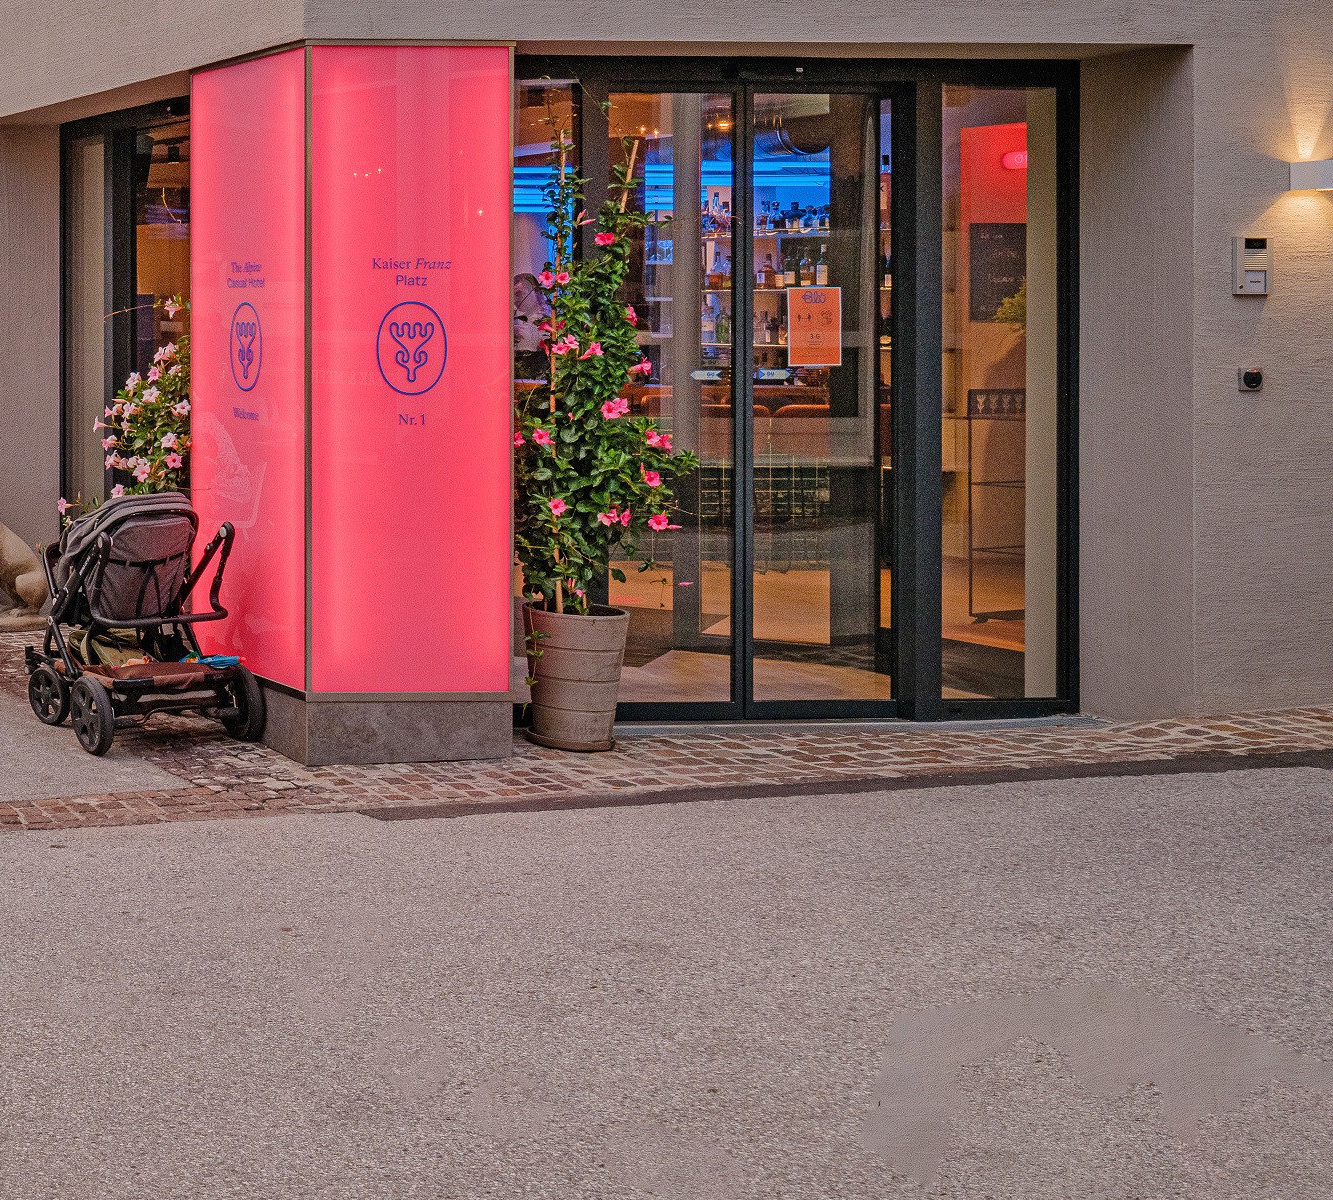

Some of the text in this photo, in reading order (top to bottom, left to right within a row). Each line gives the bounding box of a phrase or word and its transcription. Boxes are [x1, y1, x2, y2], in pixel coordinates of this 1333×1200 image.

[231, 261, 242, 272] The
[372, 257, 452, 269] Kaiser Franz
[227, 277, 265, 288] Casual Hotel
[396, 274, 428, 286] Platz
[398, 413, 427, 425] Nr. 1
